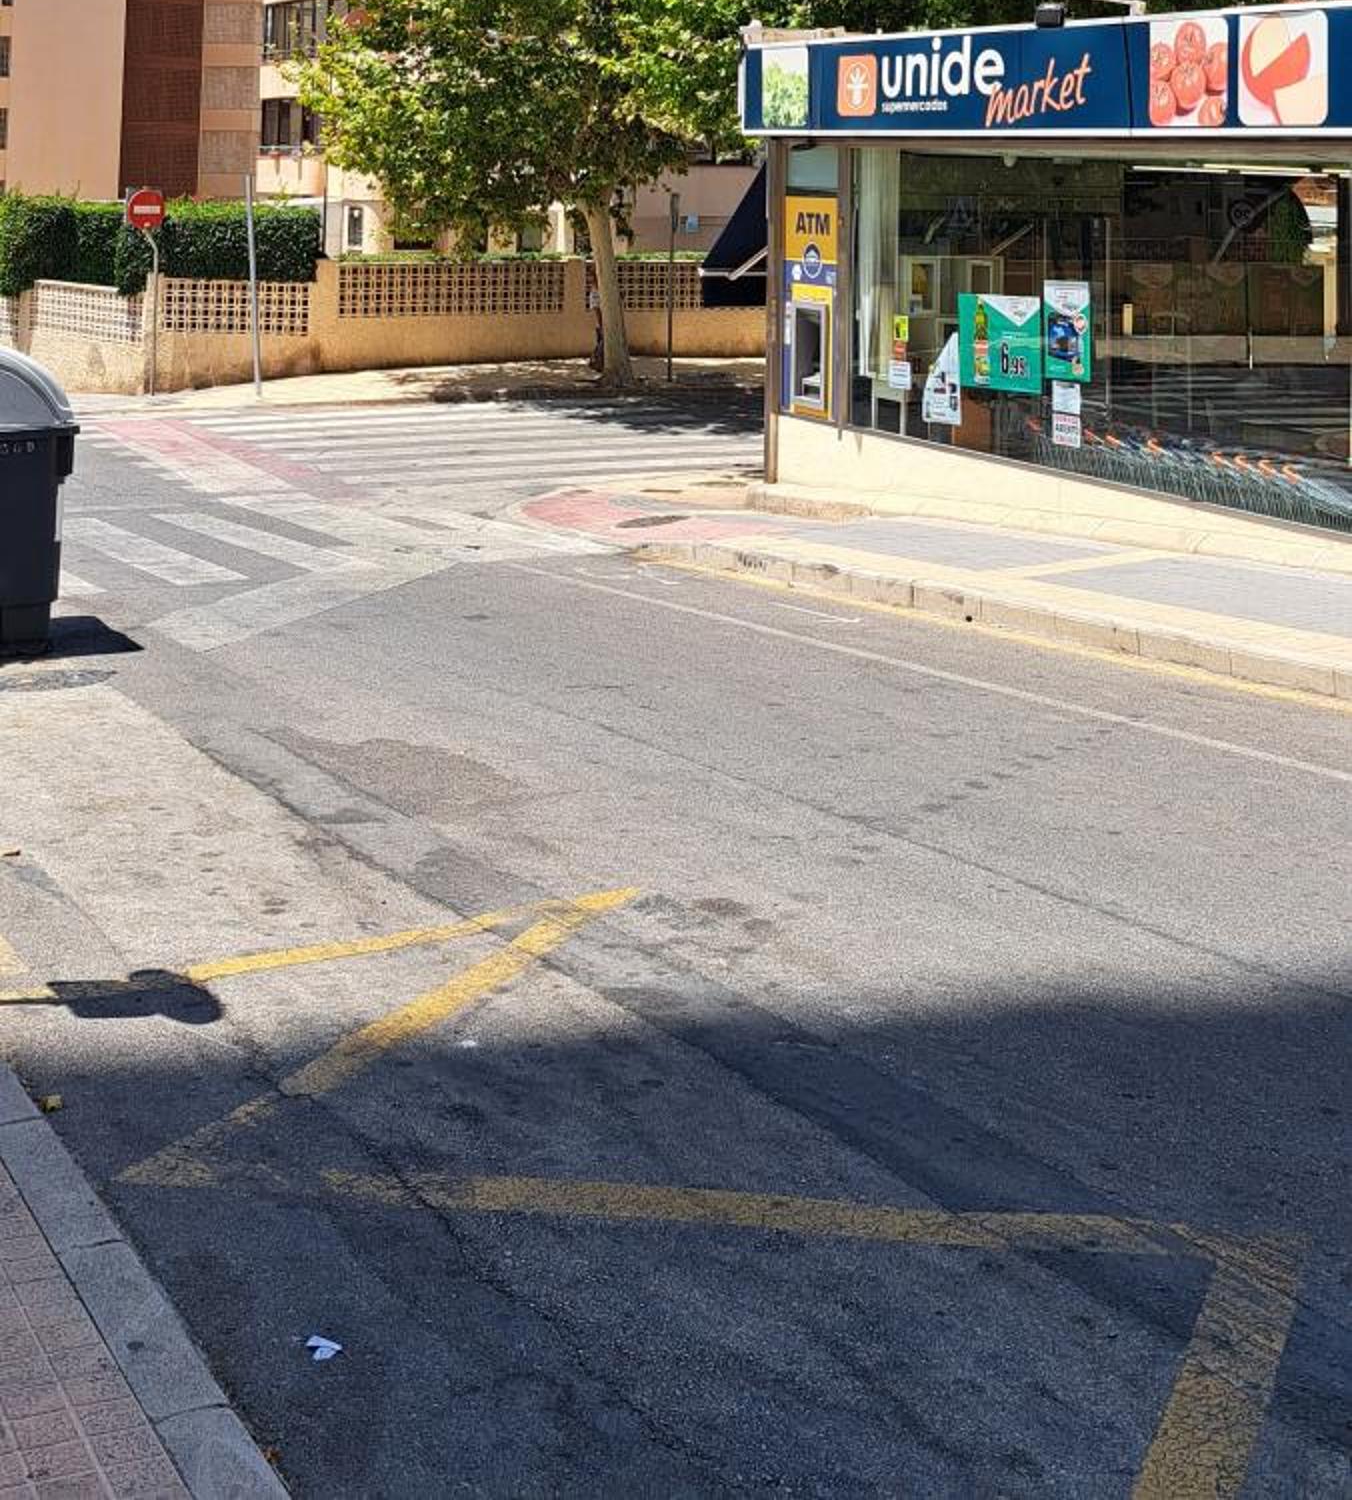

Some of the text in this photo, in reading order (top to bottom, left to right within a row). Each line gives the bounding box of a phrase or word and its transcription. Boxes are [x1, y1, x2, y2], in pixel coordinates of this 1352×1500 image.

[881, 35, 1005, 99] unide
[881, 100, 948, 113] supermercados
[985, 52, 1091, 128] market
[795, 211, 831, 237] ATM
